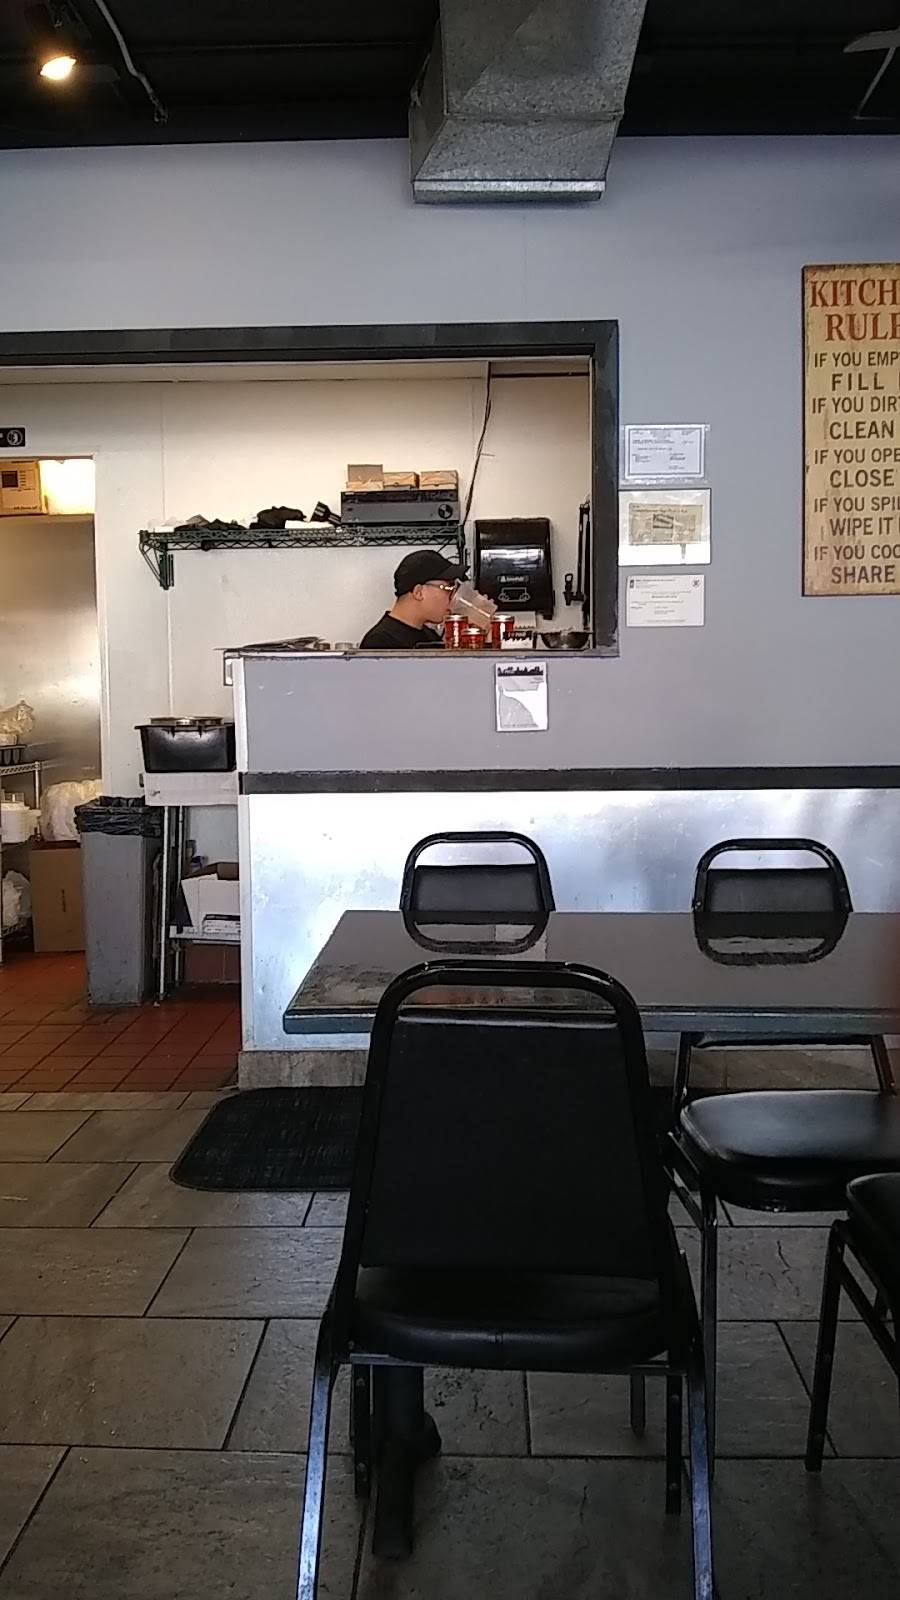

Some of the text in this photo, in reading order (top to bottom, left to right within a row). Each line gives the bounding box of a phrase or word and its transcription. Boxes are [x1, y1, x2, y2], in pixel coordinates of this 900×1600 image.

[814, 351, 900, 368] IF YOU EMP
[832, 372, 885, 391] FILL
[812, 396, 900, 413] IF YOU DIR
[829, 420, 894, 440] CLEAN
[814, 449, 828, 464] IF
[834, 448, 865, 464] YOU
[830, 469, 895, 488] CLOSE
[814, 498, 828, 512] IF
[833, 497, 865, 512] YOU
[829, 517, 894, 536] WIPE IT
[814, 546, 829, 561] IF
[833, 545, 865, 560] YOU
[831, 564, 896, 584] SHARE
